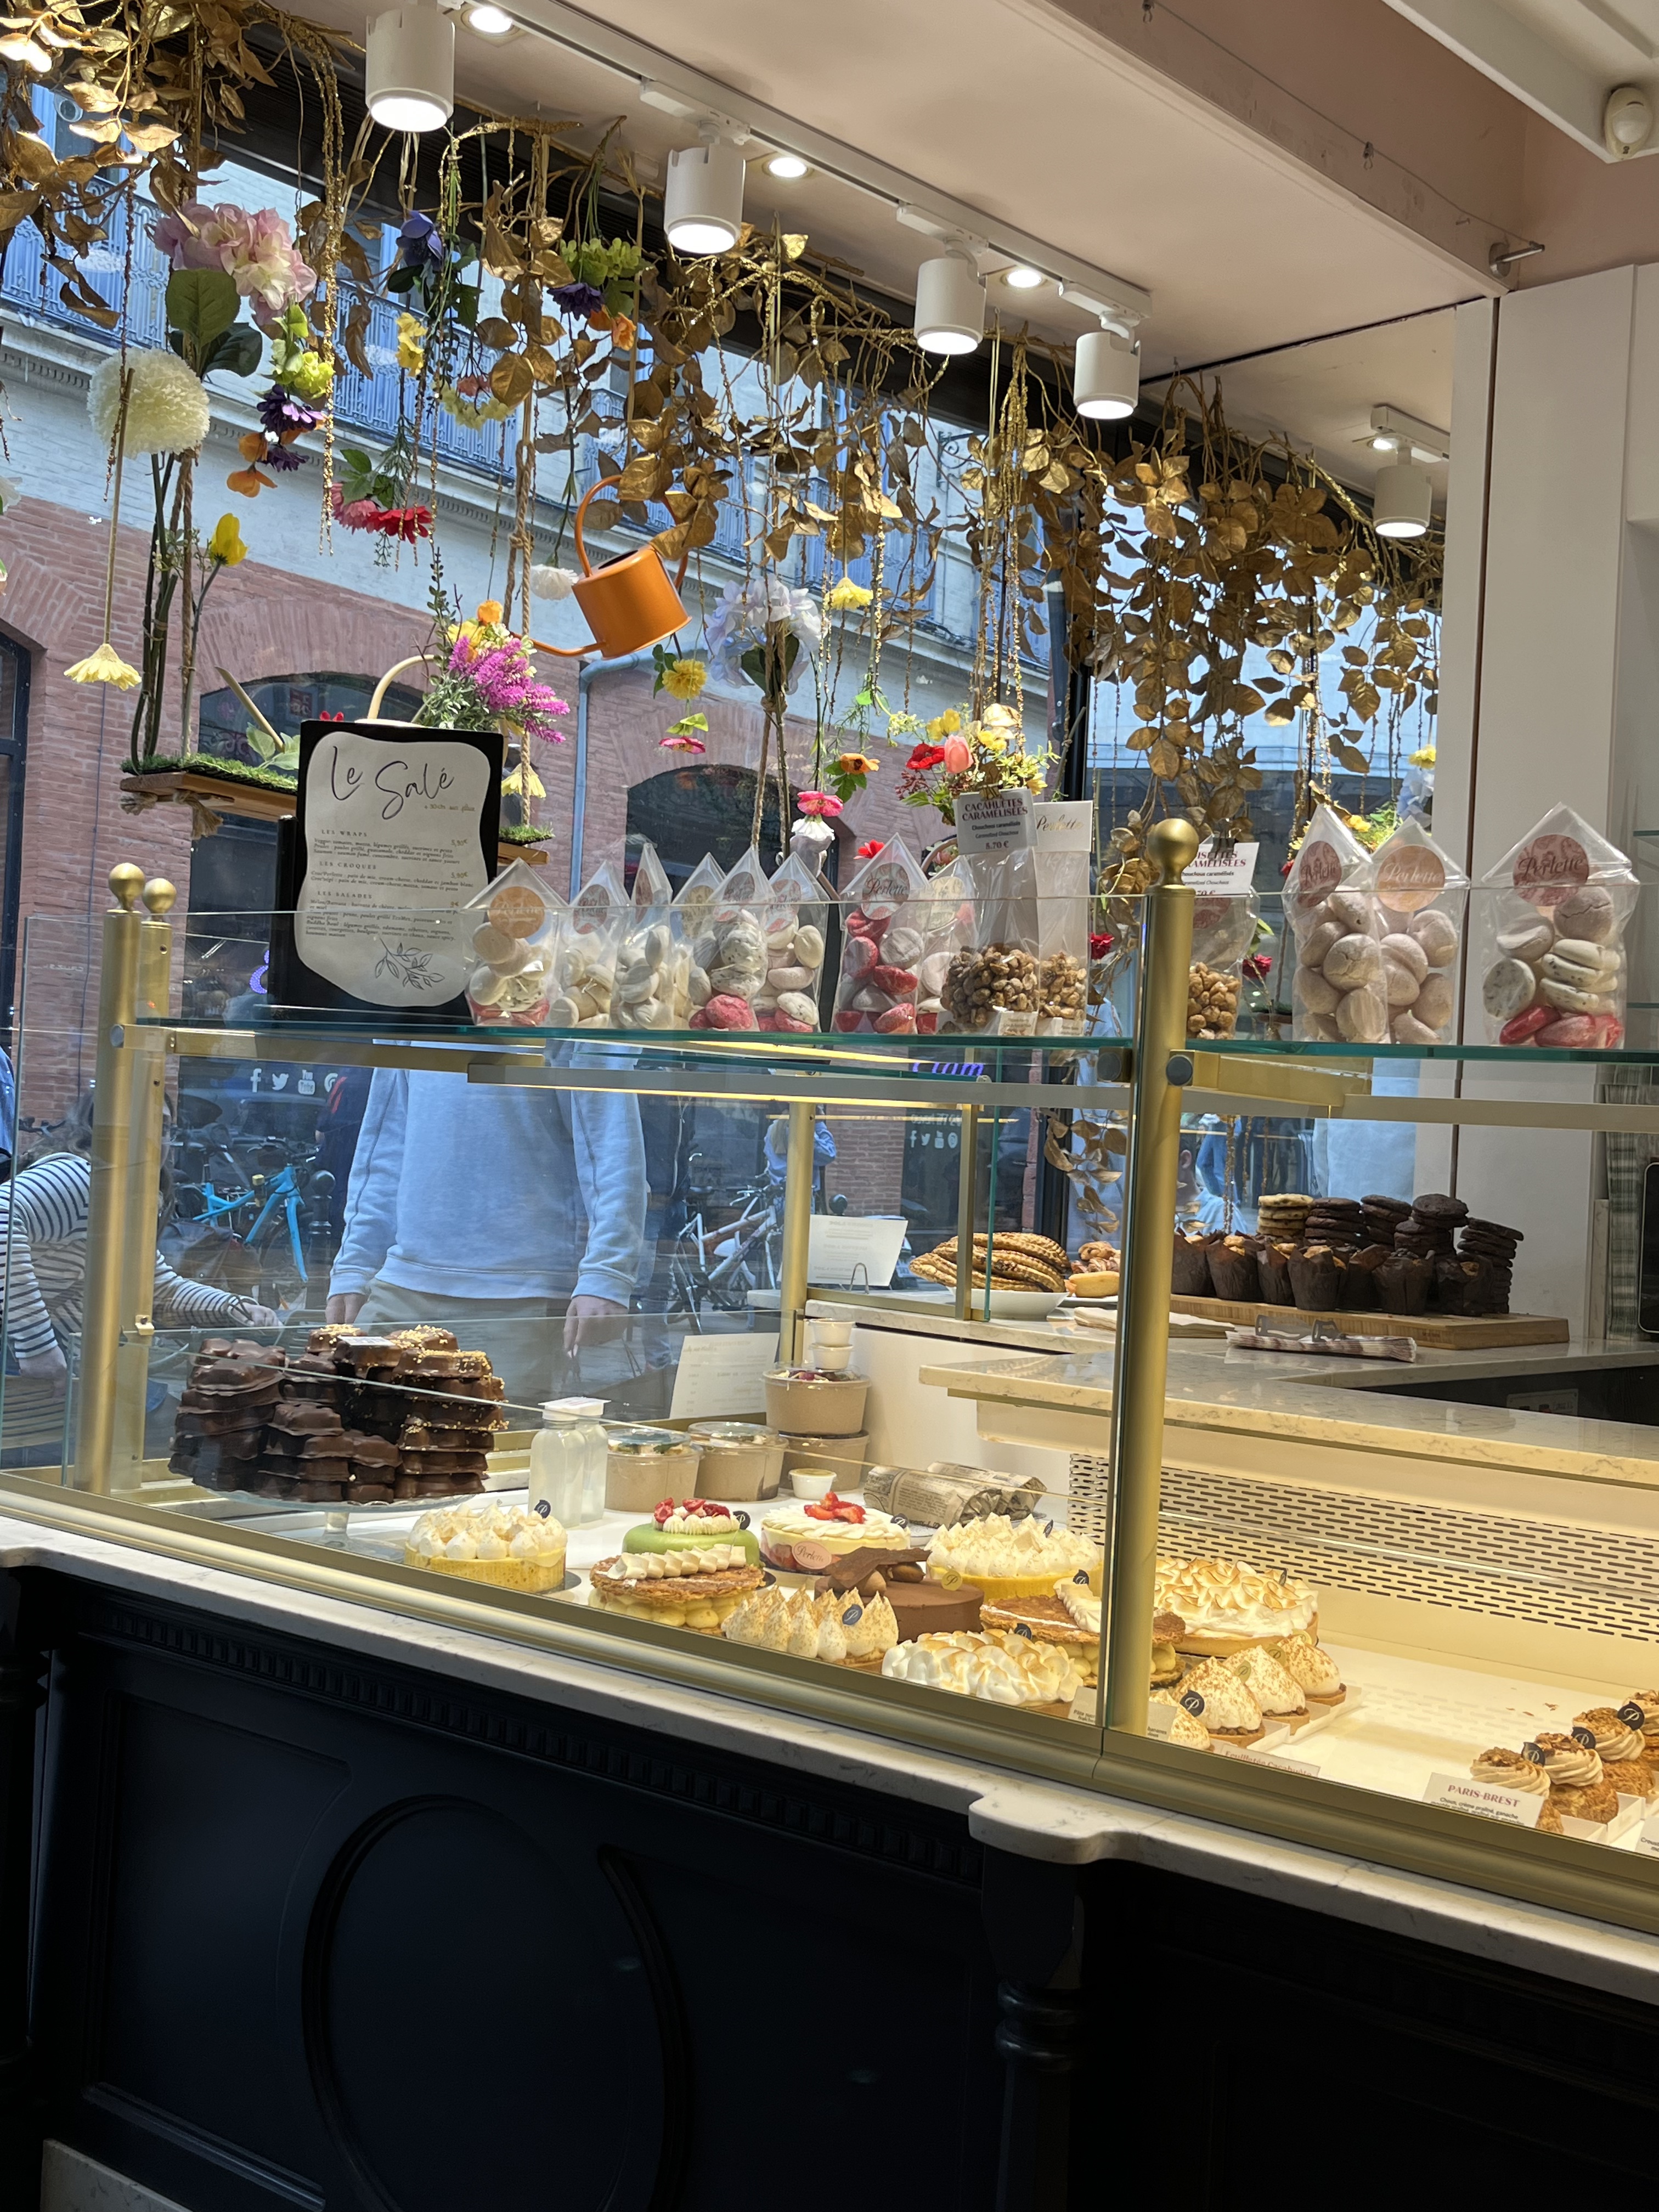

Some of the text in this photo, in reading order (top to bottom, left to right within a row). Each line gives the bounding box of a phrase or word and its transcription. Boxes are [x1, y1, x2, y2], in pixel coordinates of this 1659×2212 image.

[331, 746, 455, 820] Le Salé
[1036, 814, 1084, 832] Perlette
[1383, 863, 1441, 883] Perlette
[1518, 855, 1583, 879] Perlette
[866, 878, 908, 896] Perlette
[1447, 1784, 1521, 1808] PARIS-BREST
[1458, 1801, 1475, 1809] crème
[1496, 1809, 1519, 1820] ganache
